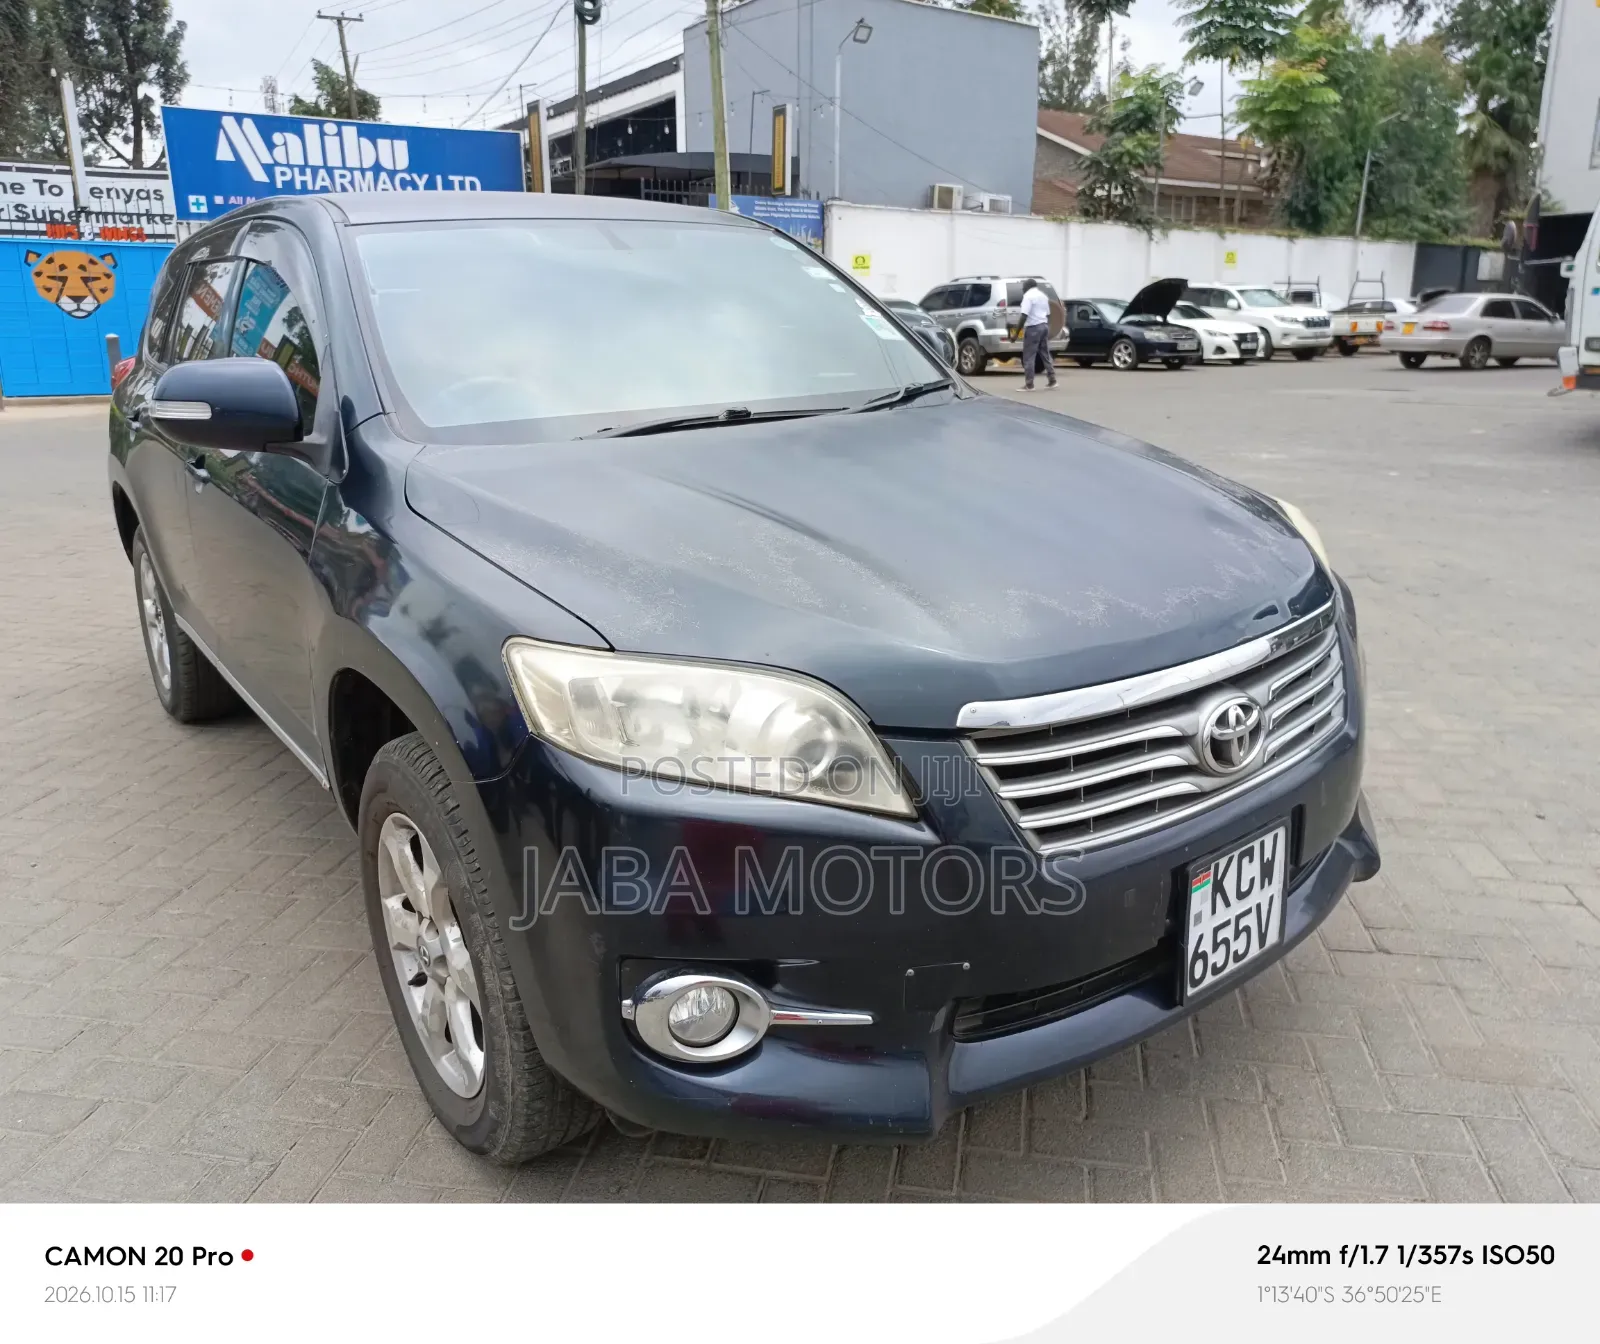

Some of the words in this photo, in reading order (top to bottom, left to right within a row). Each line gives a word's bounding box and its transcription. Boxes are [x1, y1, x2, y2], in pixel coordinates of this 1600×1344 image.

[215, 115, 410, 183] Malibu
[274, 166, 430, 193] PHARMACY
[32, 178, 64, 197] To
[89, 185, 164, 204] enyas
[1211, 832, 1279, 916] KCW
[1188, 894, 1275, 989] 655V
